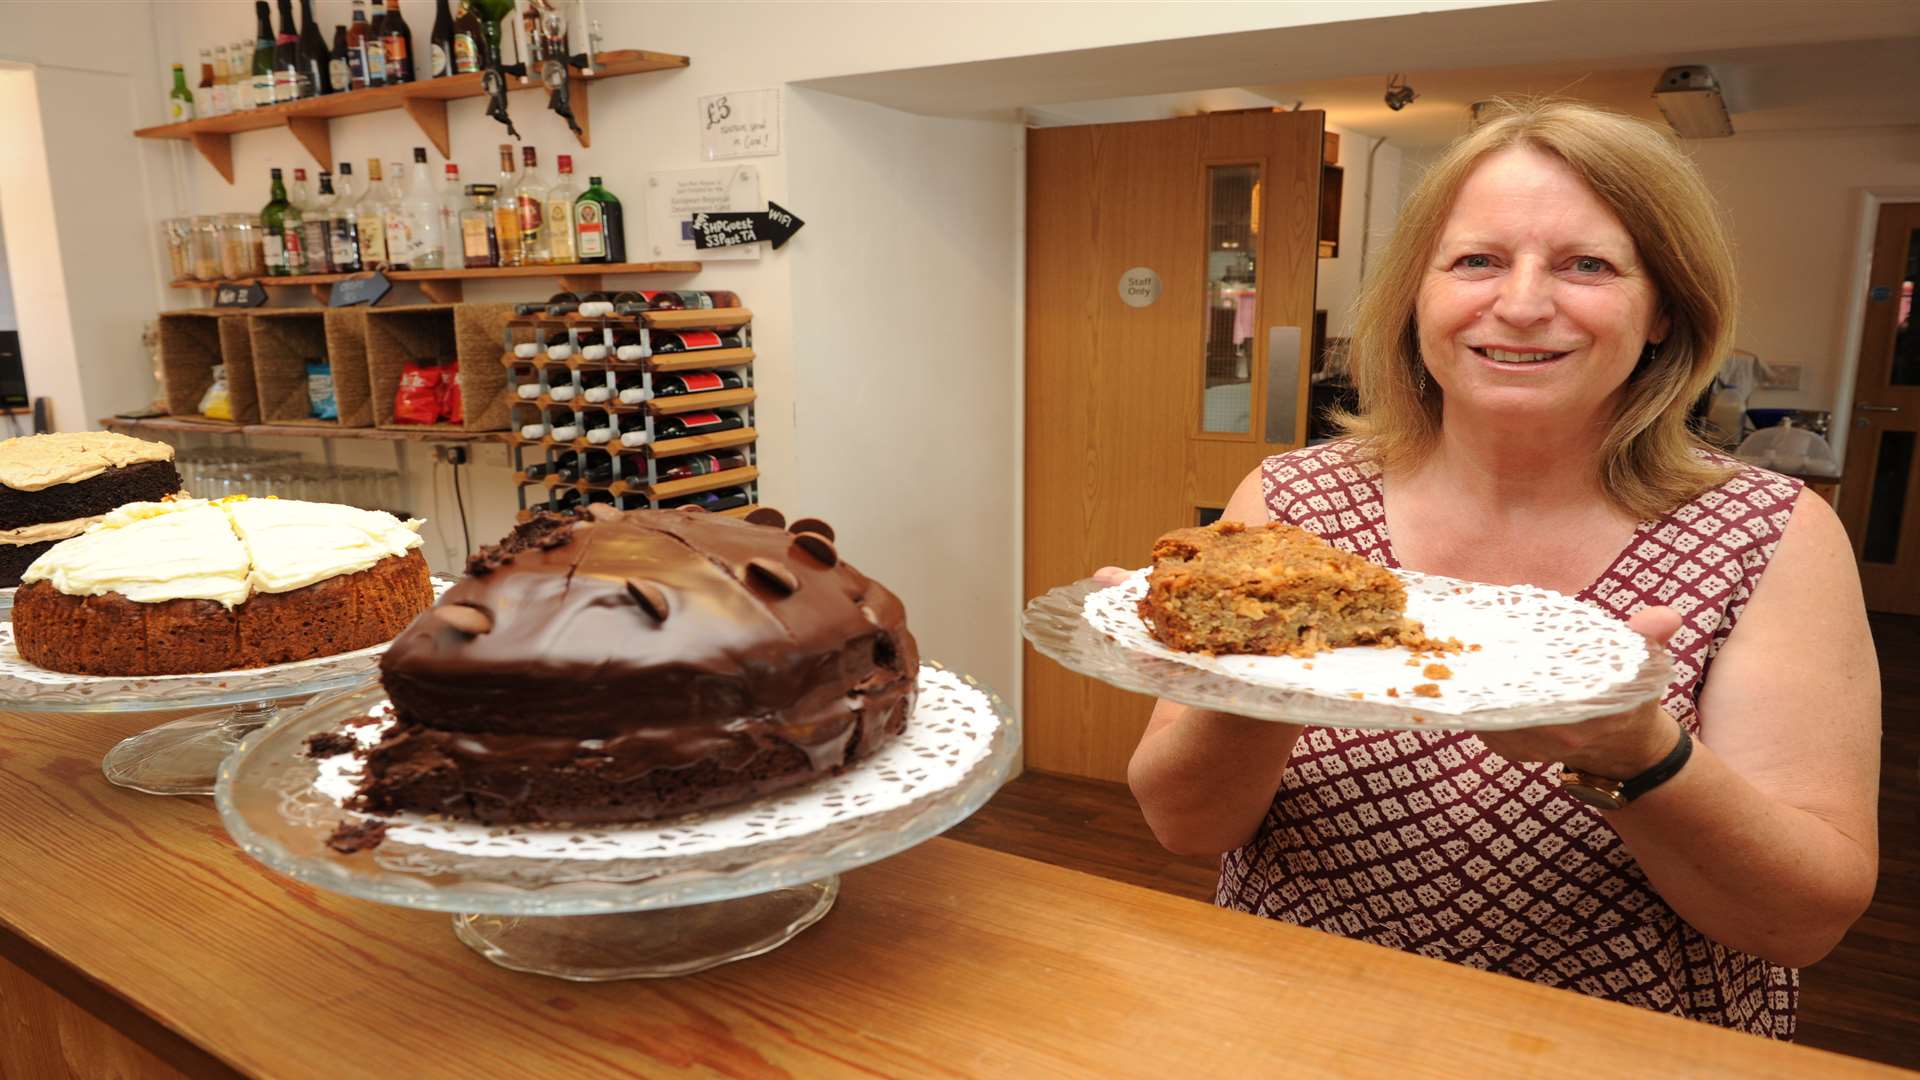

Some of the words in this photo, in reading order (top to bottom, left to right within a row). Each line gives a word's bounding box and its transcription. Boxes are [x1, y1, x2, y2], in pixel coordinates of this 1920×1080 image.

[706, 96, 730, 130] £3
[1128, 277, 1151, 286] Staff
[1128, 288, 1151, 297] Only
